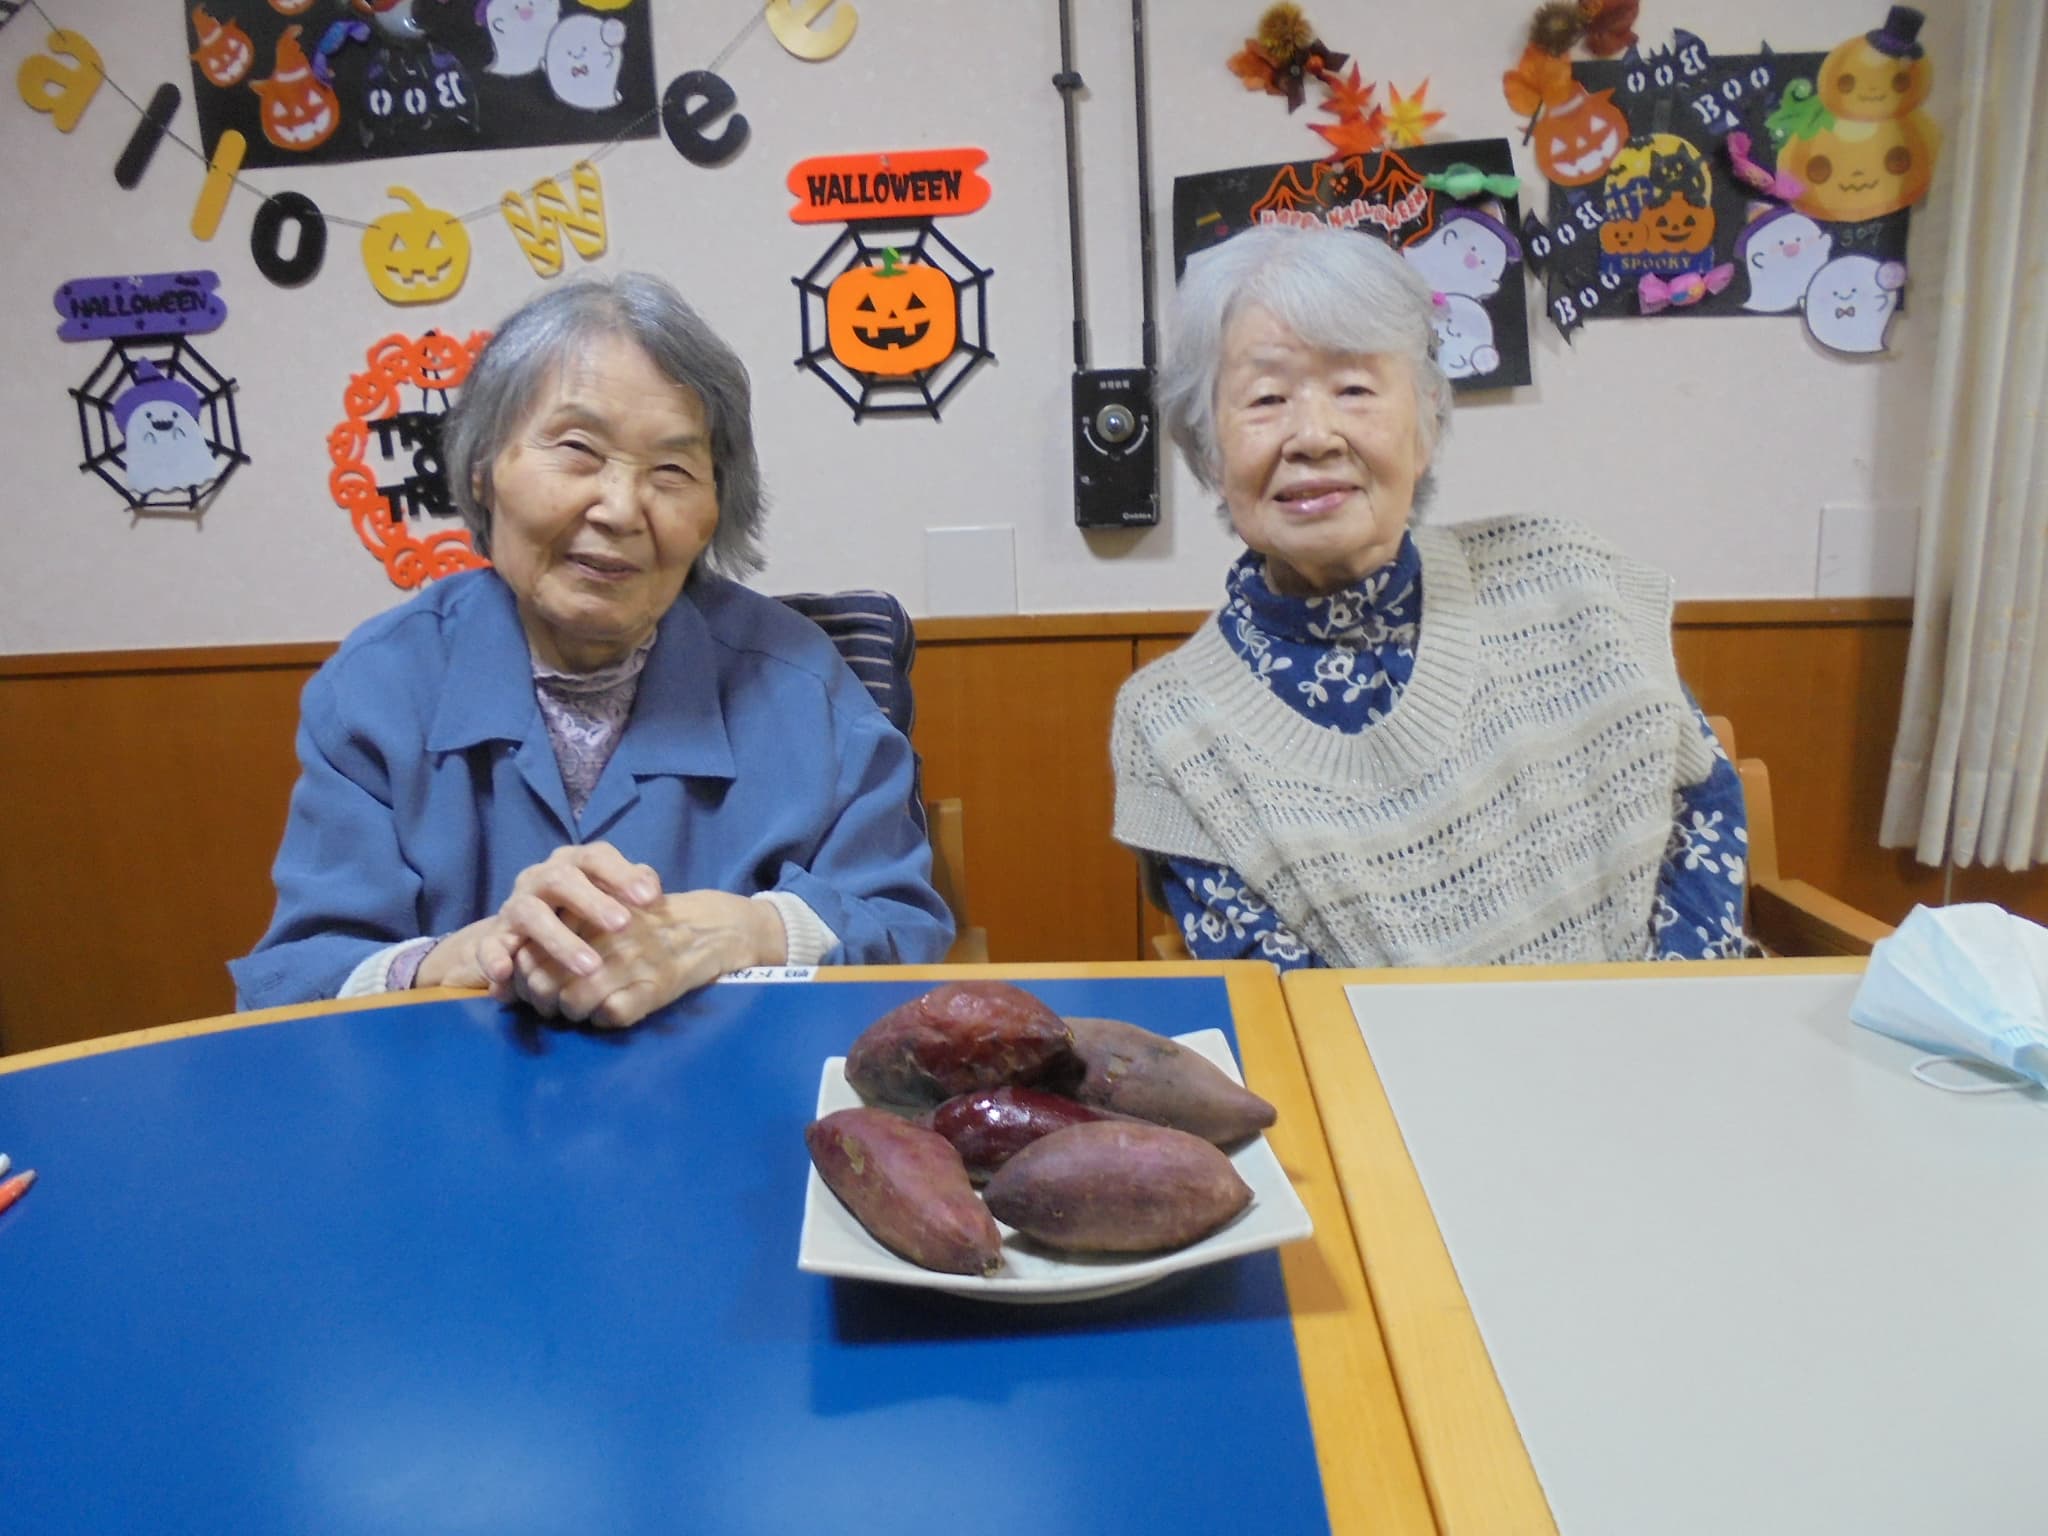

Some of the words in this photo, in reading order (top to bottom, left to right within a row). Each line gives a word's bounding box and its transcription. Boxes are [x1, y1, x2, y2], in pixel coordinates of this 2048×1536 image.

[807, 170, 962, 207] HALLOWEEN
[1620, 256, 1693, 271] SPOOKY
[68, 288, 209, 320] HALLOWEEN
